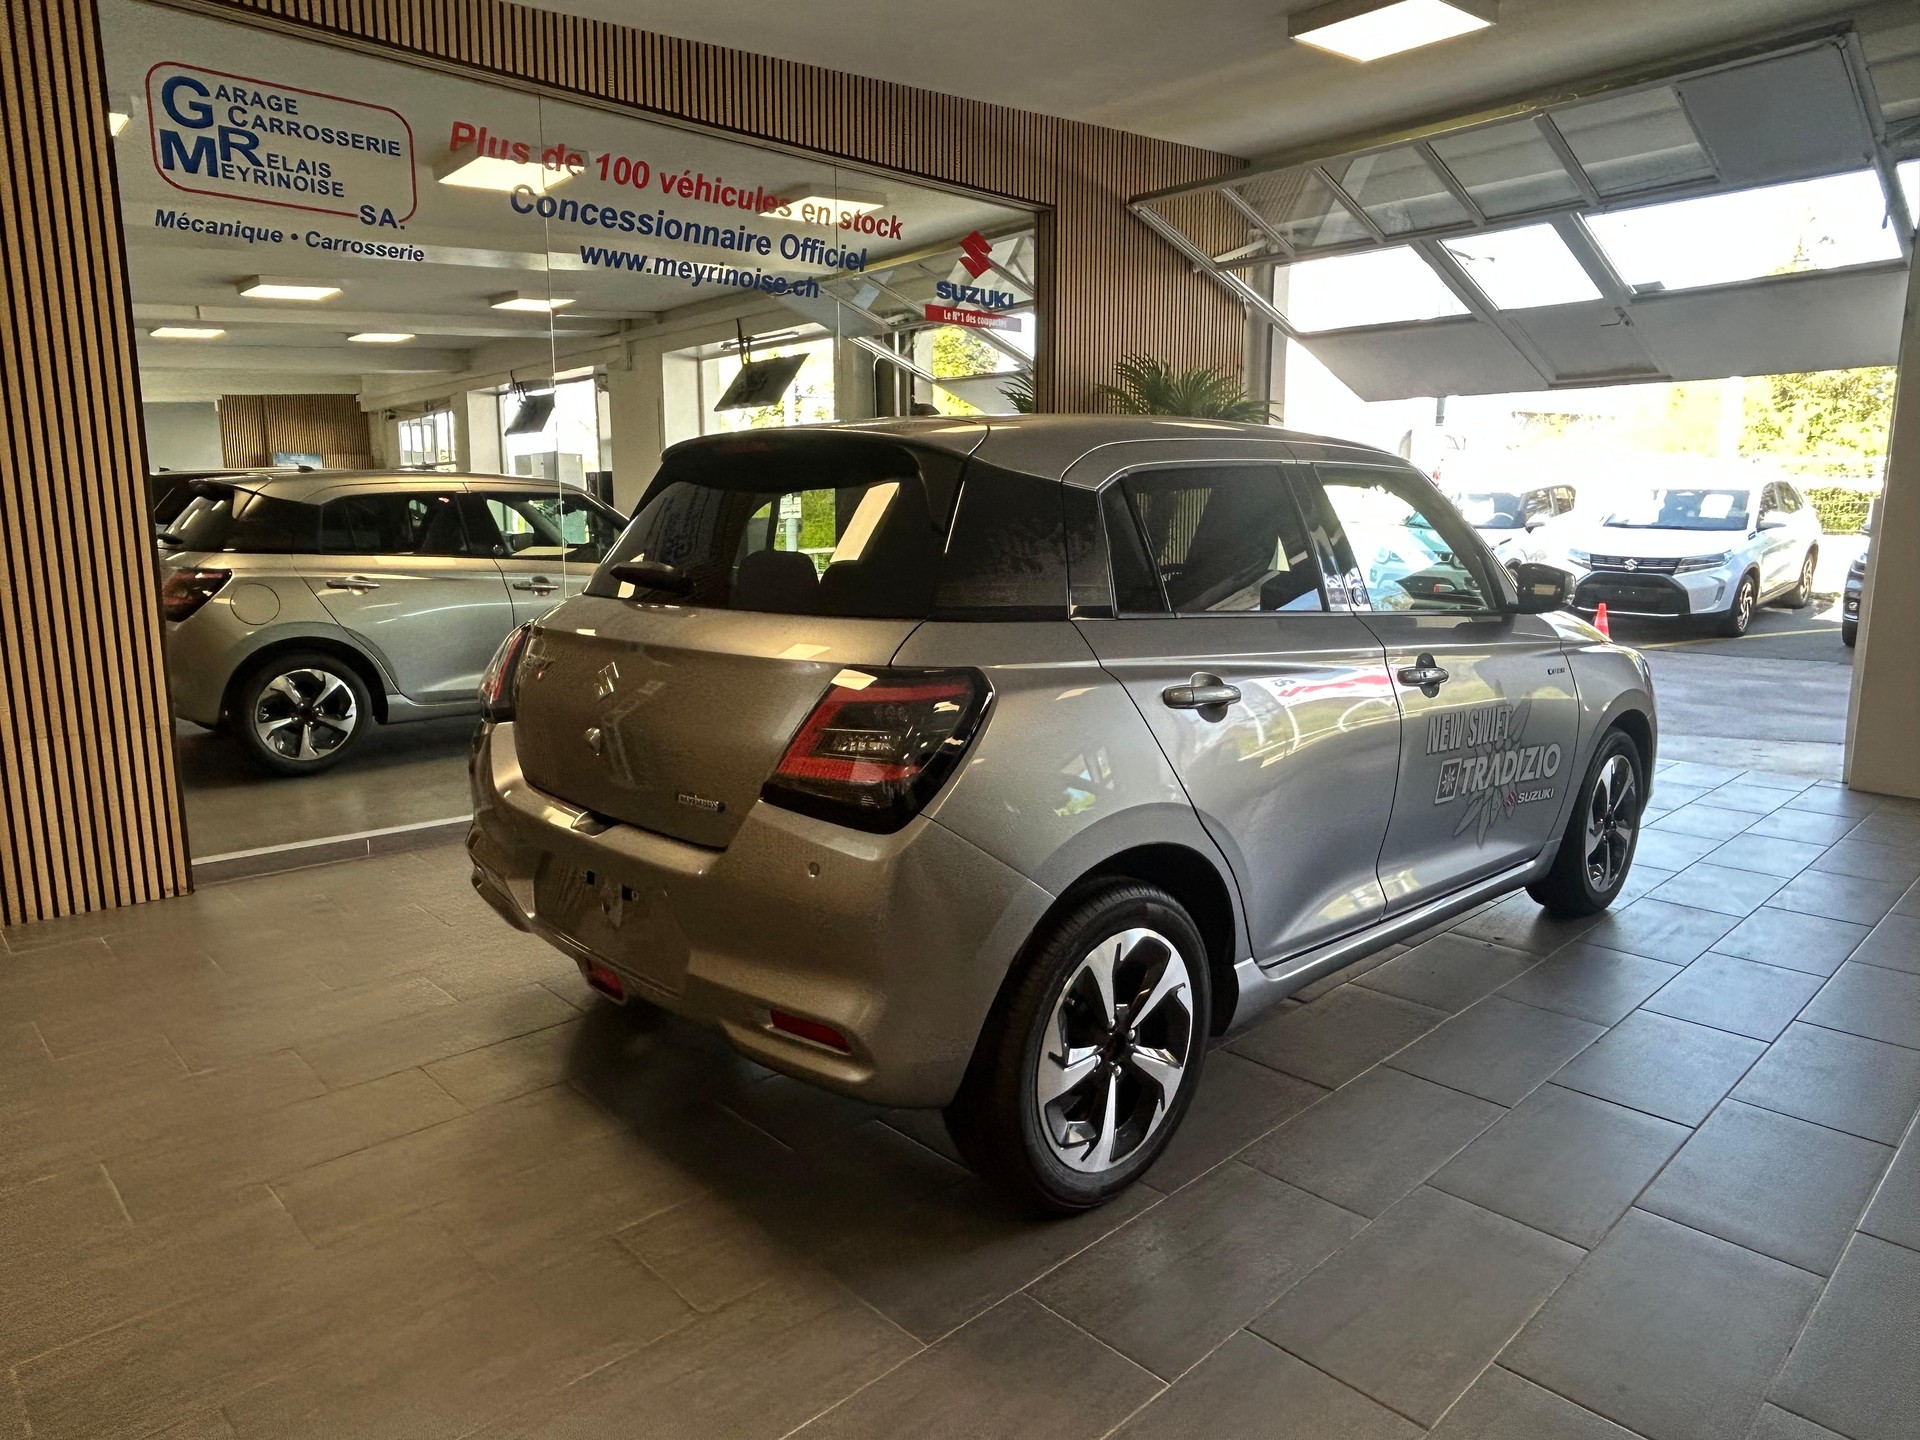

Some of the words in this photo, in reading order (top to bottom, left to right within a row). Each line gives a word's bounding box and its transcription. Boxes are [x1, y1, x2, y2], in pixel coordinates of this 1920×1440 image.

[161, 75, 299, 130] GARAGE
[217, 124, 333, 179] RELAIS
[227, 105, 402, 157] CARROSSERIE
[159, 128, 346, 199] MEYRINOISE
[449, 120, 530, 166] Plus
[541, 143, 585, 177] de
[595, 152, 650, 190] 100
[659, 169, 793, 219] véhicules
[801, 200, 833, 227] en
[838, 207, 903, 241] stock
[155, 208, 284, 244] Mécanique
[305, 230, 426, 263] Carrosserie
[359, 204, 406, 230] SA.
[509, 184, 772, 257] Concessionnaire
[779, 233, 868, 273] Officiel
[579, 244, 820, 300] www.meyrinoise.ch
[936, 280, 1015, 309] SUZUKI
[965, 313, 977, 324] des
[1426, 710, 1466, 756] NEW
[1466, 703, 1514, 748] SWIFT
[1460, 743, 1562, 796] TRADIZIO
[1516, 787, 1555, 804] SUZUKI
